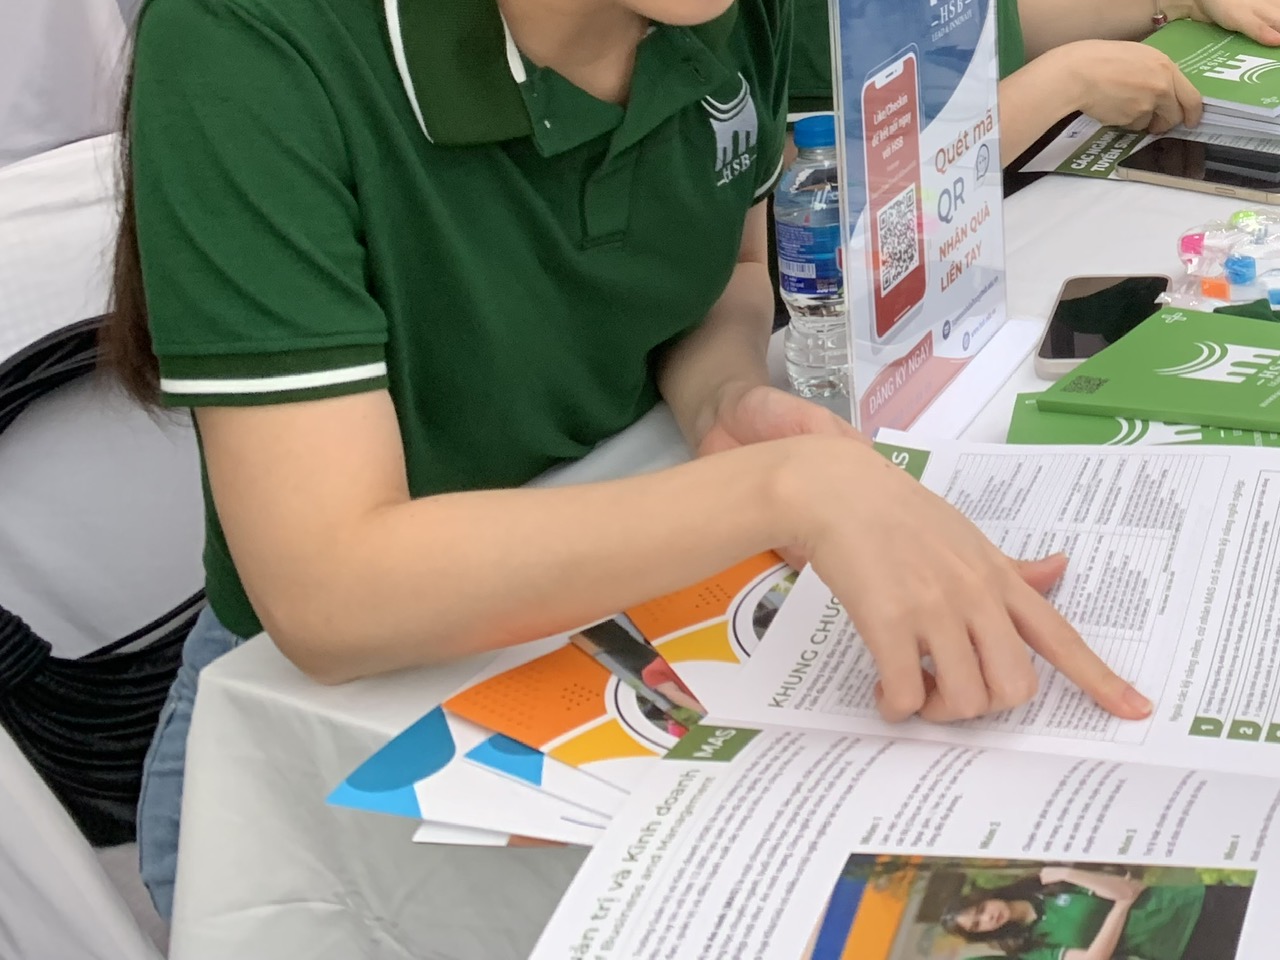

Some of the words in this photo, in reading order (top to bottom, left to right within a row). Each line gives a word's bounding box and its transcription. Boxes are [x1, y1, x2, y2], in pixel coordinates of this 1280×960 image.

[934, 130, 970, 175] Quét
[973, 108, 993, 145] mã
[722, 153, 751, 183] HSB
[1071, 153, 1095, 169] CÁC
[1090, 148, 1123, 171] TUYỂN
[937, 176, 965, 224] QR
[939, 223, 967, 262] NHẬN
[970, 201, 991, 233] QUÀ
[964, 241, 983, 269] TAY
[908, 339, 931, 375] NGAY
[768, 650, 818, 708] KHUNG
[693, 728, 737, 758] MAS
[1239, 727, 1253, 735] 2
[591, 896, 620, 921] trị
[608, 867, 632, 893] và
[622, 819, 662, 863] Kinh
[656, 768, 701, 817] doanh
